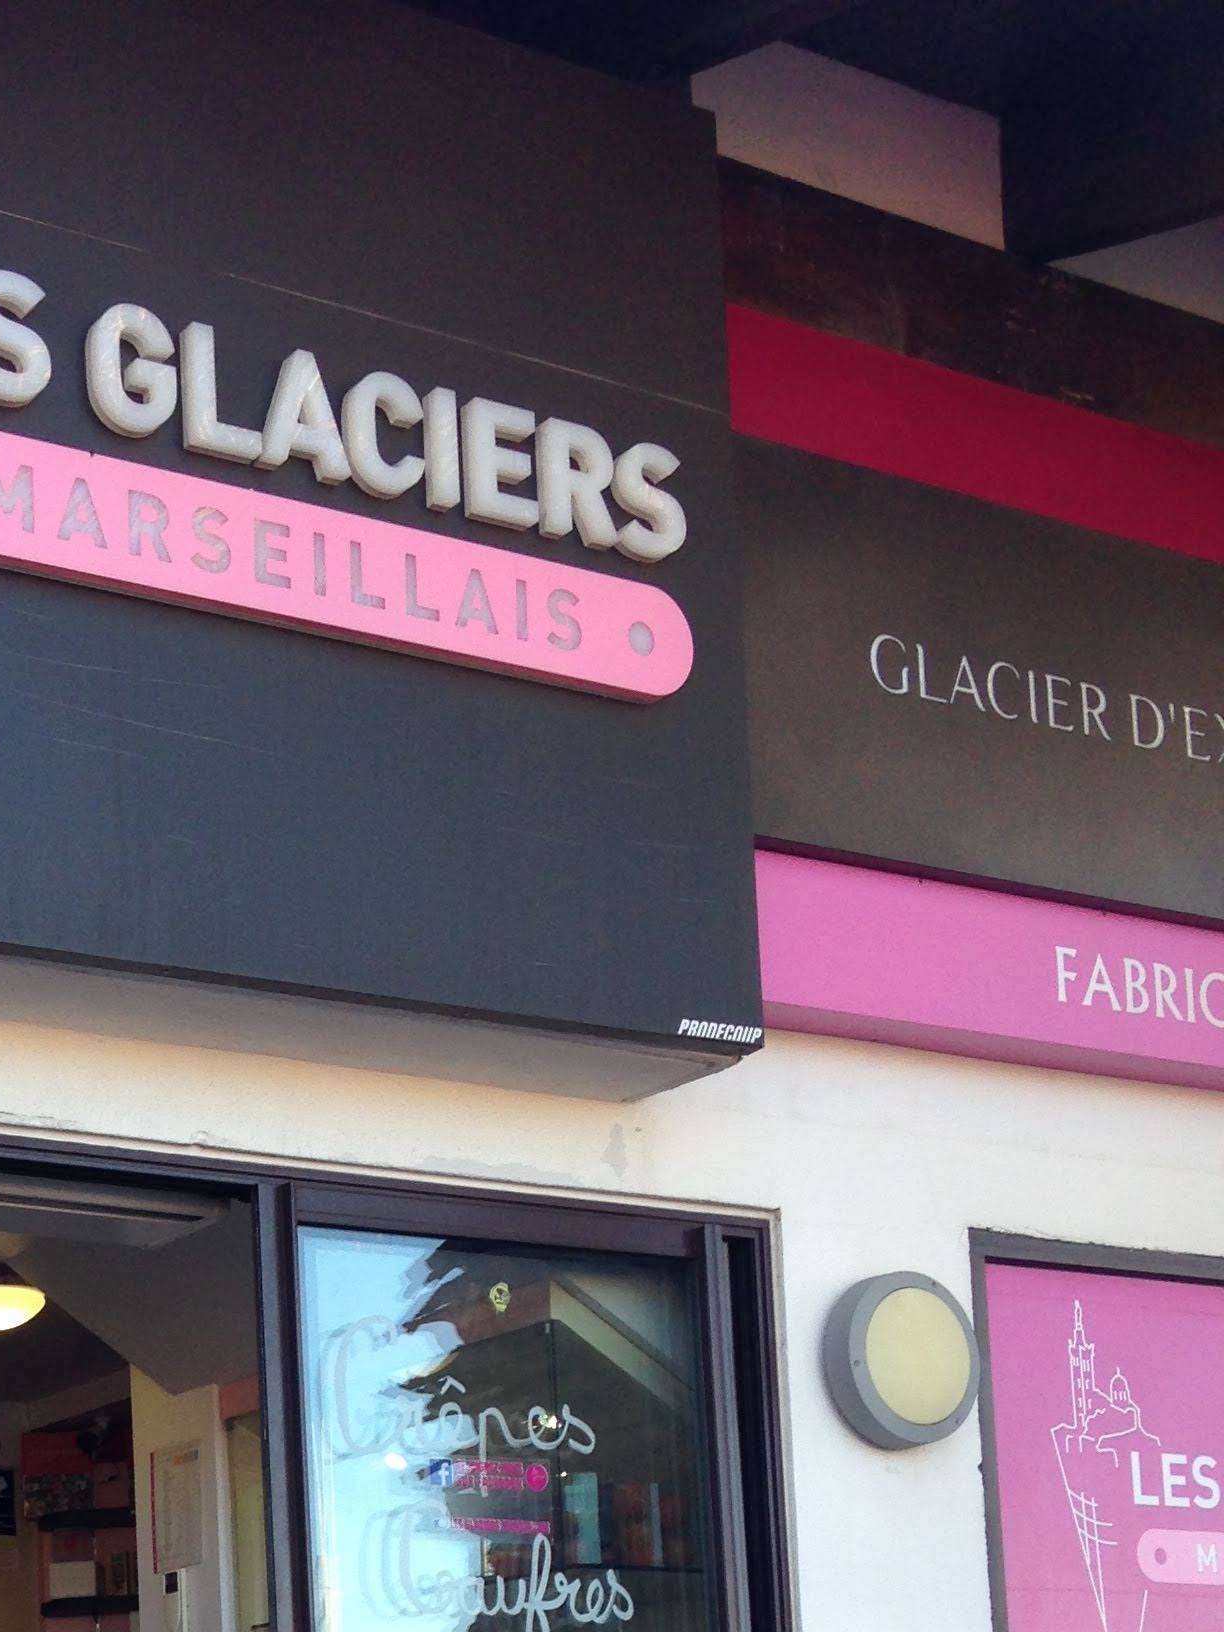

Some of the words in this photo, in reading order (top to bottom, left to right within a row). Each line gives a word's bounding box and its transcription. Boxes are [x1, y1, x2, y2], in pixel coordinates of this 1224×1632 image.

[84, 302, 688, 563] GLACIERS
[869, 632, 1111, 742] GLACIER
[1128, 692, 1224, 764] D'E
[1130, 1450, 1221, 1510] LES
